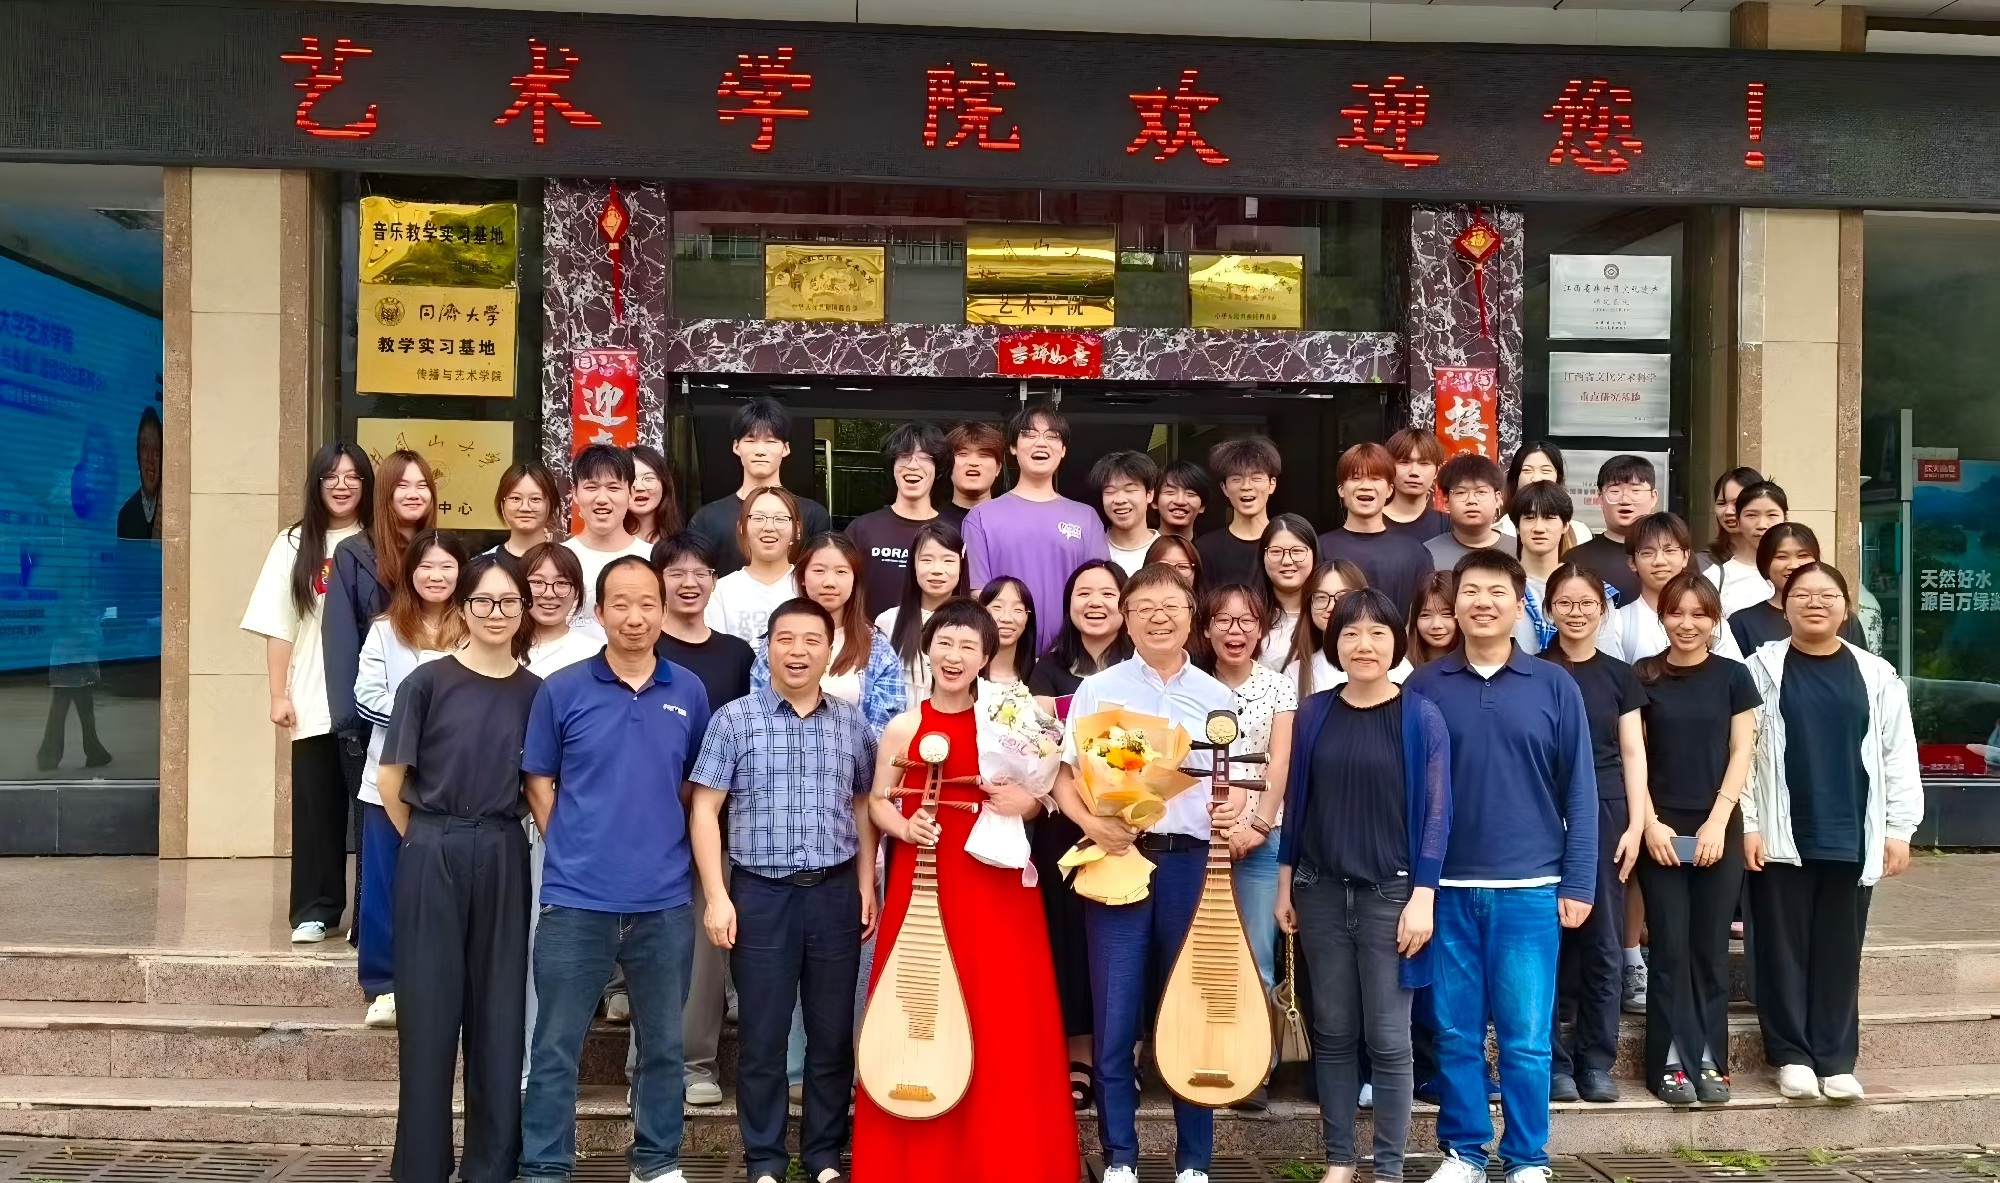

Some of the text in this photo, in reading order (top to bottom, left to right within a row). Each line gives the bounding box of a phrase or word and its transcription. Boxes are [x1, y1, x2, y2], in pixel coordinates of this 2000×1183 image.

[372, 220, 505, 246] 音乐教学实习基地
[999, 293, 1084, 315] 艺术学院
[377, 336, 496, 356] 教学实习基地
[1008, 341, 1091, 368] 吉祥如意
[416, 367, 504, 382] 传播与艺术学院
[1920, 568, 1992, 589] 天然好水
